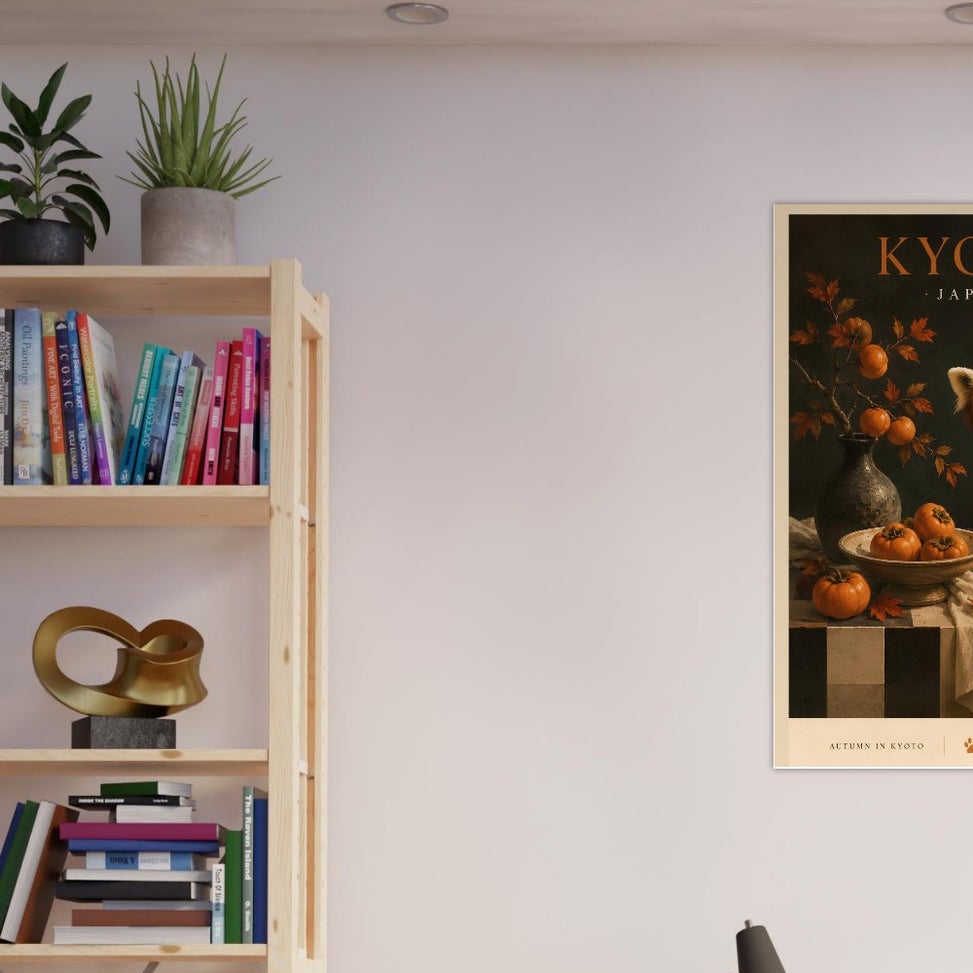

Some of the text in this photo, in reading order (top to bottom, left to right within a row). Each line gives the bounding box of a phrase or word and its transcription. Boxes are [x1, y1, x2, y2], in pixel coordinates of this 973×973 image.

[19, 325, 32, 386] Oil Paintings
[47, 347, 55, 363] FINE
[48, 364, 56, 379] ART
[59, 344, 73, 408] ICONIC
[71, 359, 80, 383] Beauty
[80, 327, 97, 410] Watercolor Portraits
[231, 363, 241, 396] Parenting
[50, 384, 58, 400] With
[177, 385, 185, 397] ART
[75, 394, 83, 408] ART
[213, 396, 222, 407] AND
[50, 402, 59, 425] Digital
[142, 397, 156, 446] SUCCESSFUL
[171, 411, 180, 427] CATS
[53, 426, 61, 441] Tools
[79, 440, 88, 472] NORMAN
[244, 794, 252, 880] The Raven Island
[244, 901, 250, 909] O.
